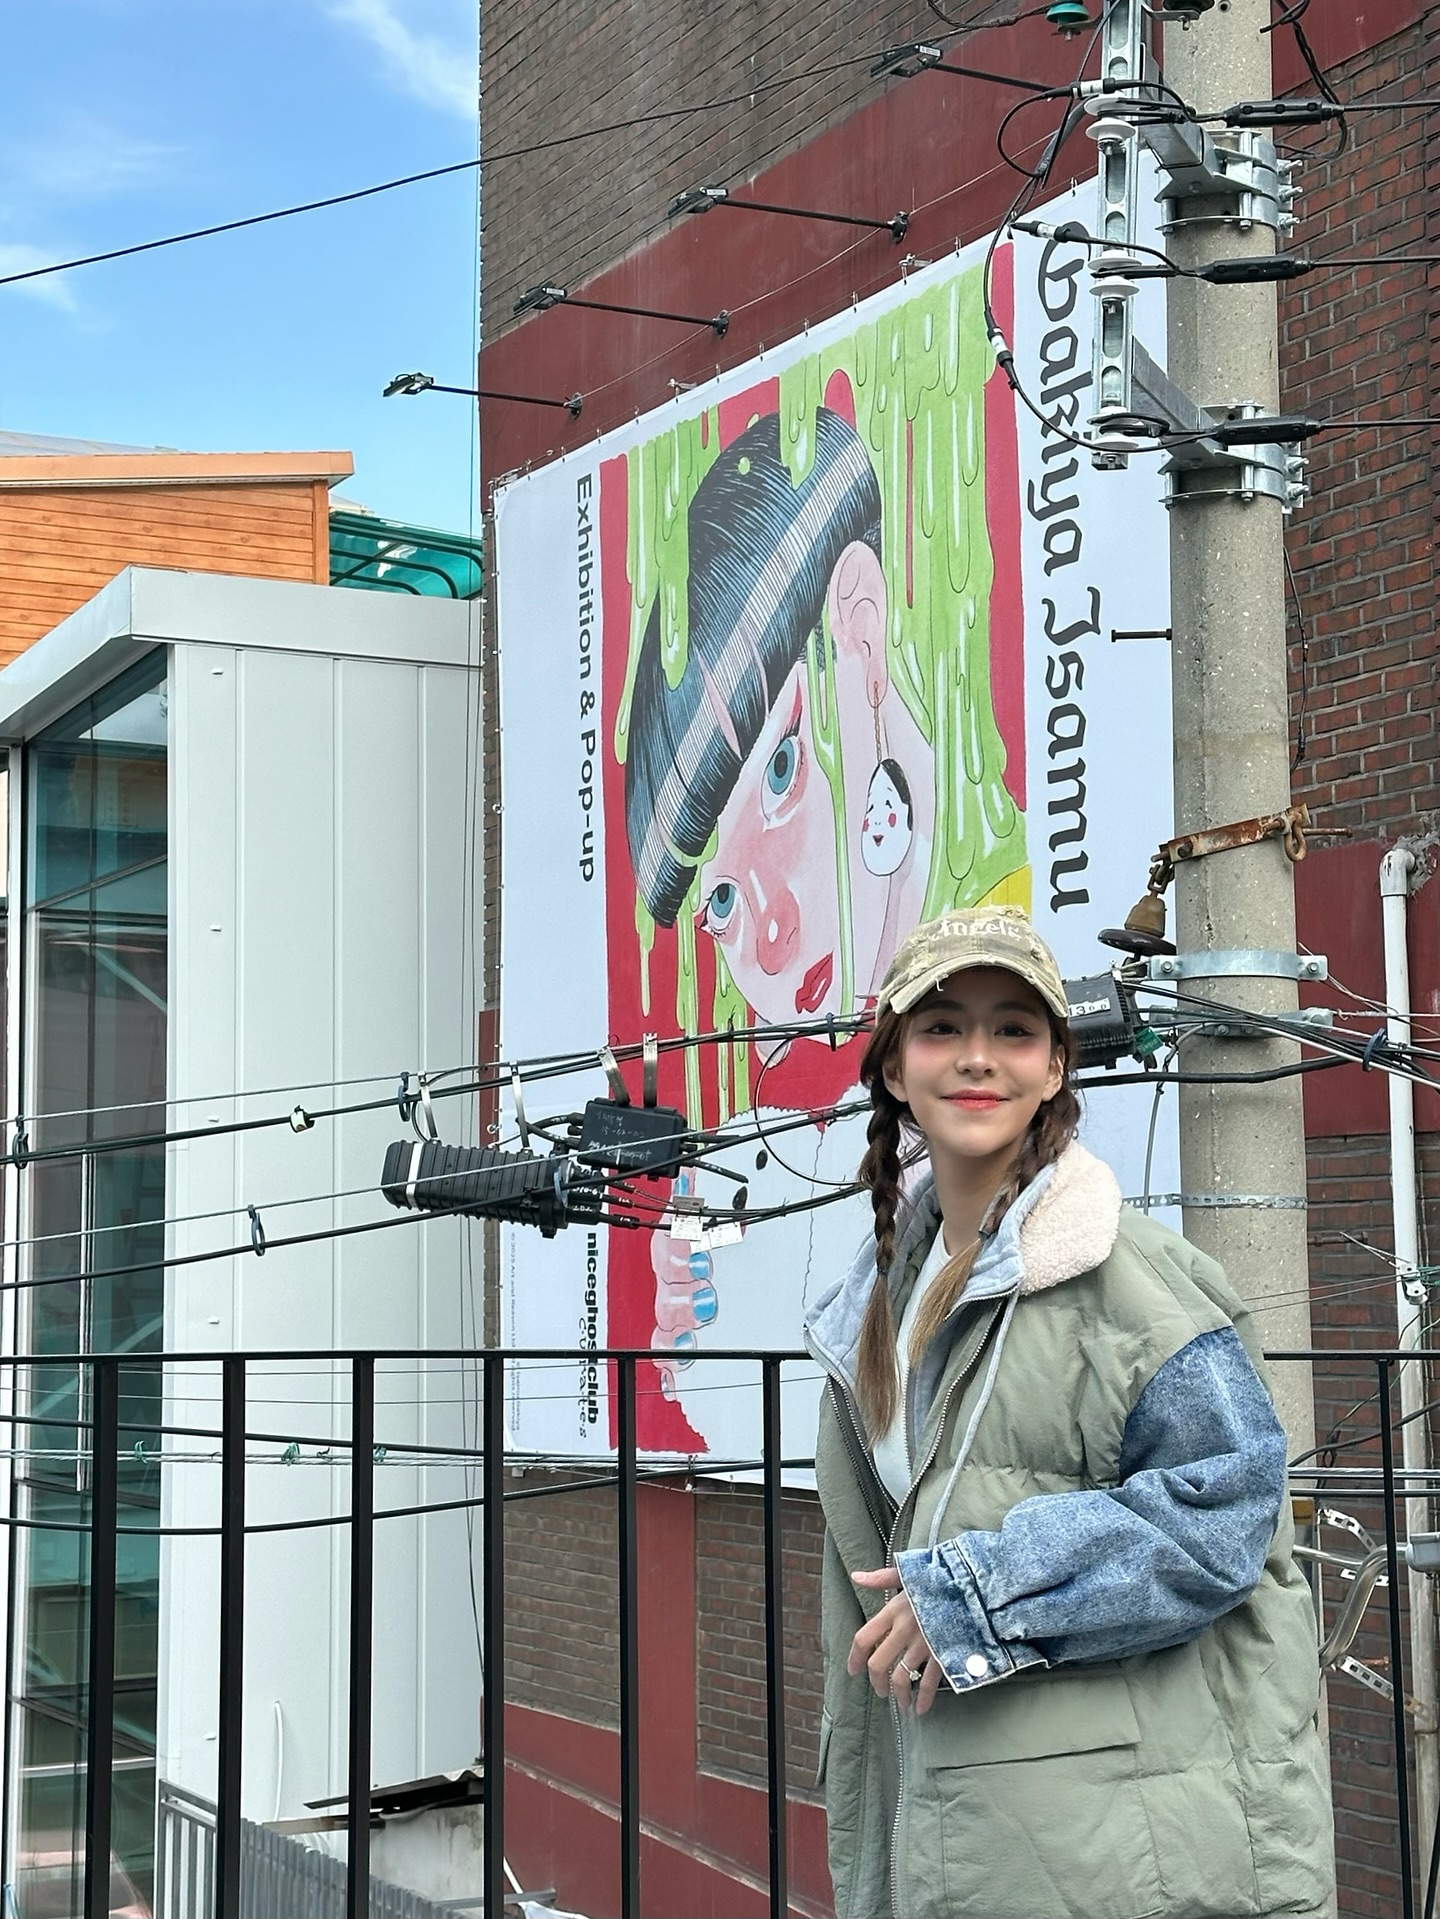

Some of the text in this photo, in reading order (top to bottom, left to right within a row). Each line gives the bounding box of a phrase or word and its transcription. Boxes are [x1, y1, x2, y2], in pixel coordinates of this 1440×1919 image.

[577, 473, 596, 882] Exhibition & Pop-up
[1041, 586, 1101, 914] Isamu
